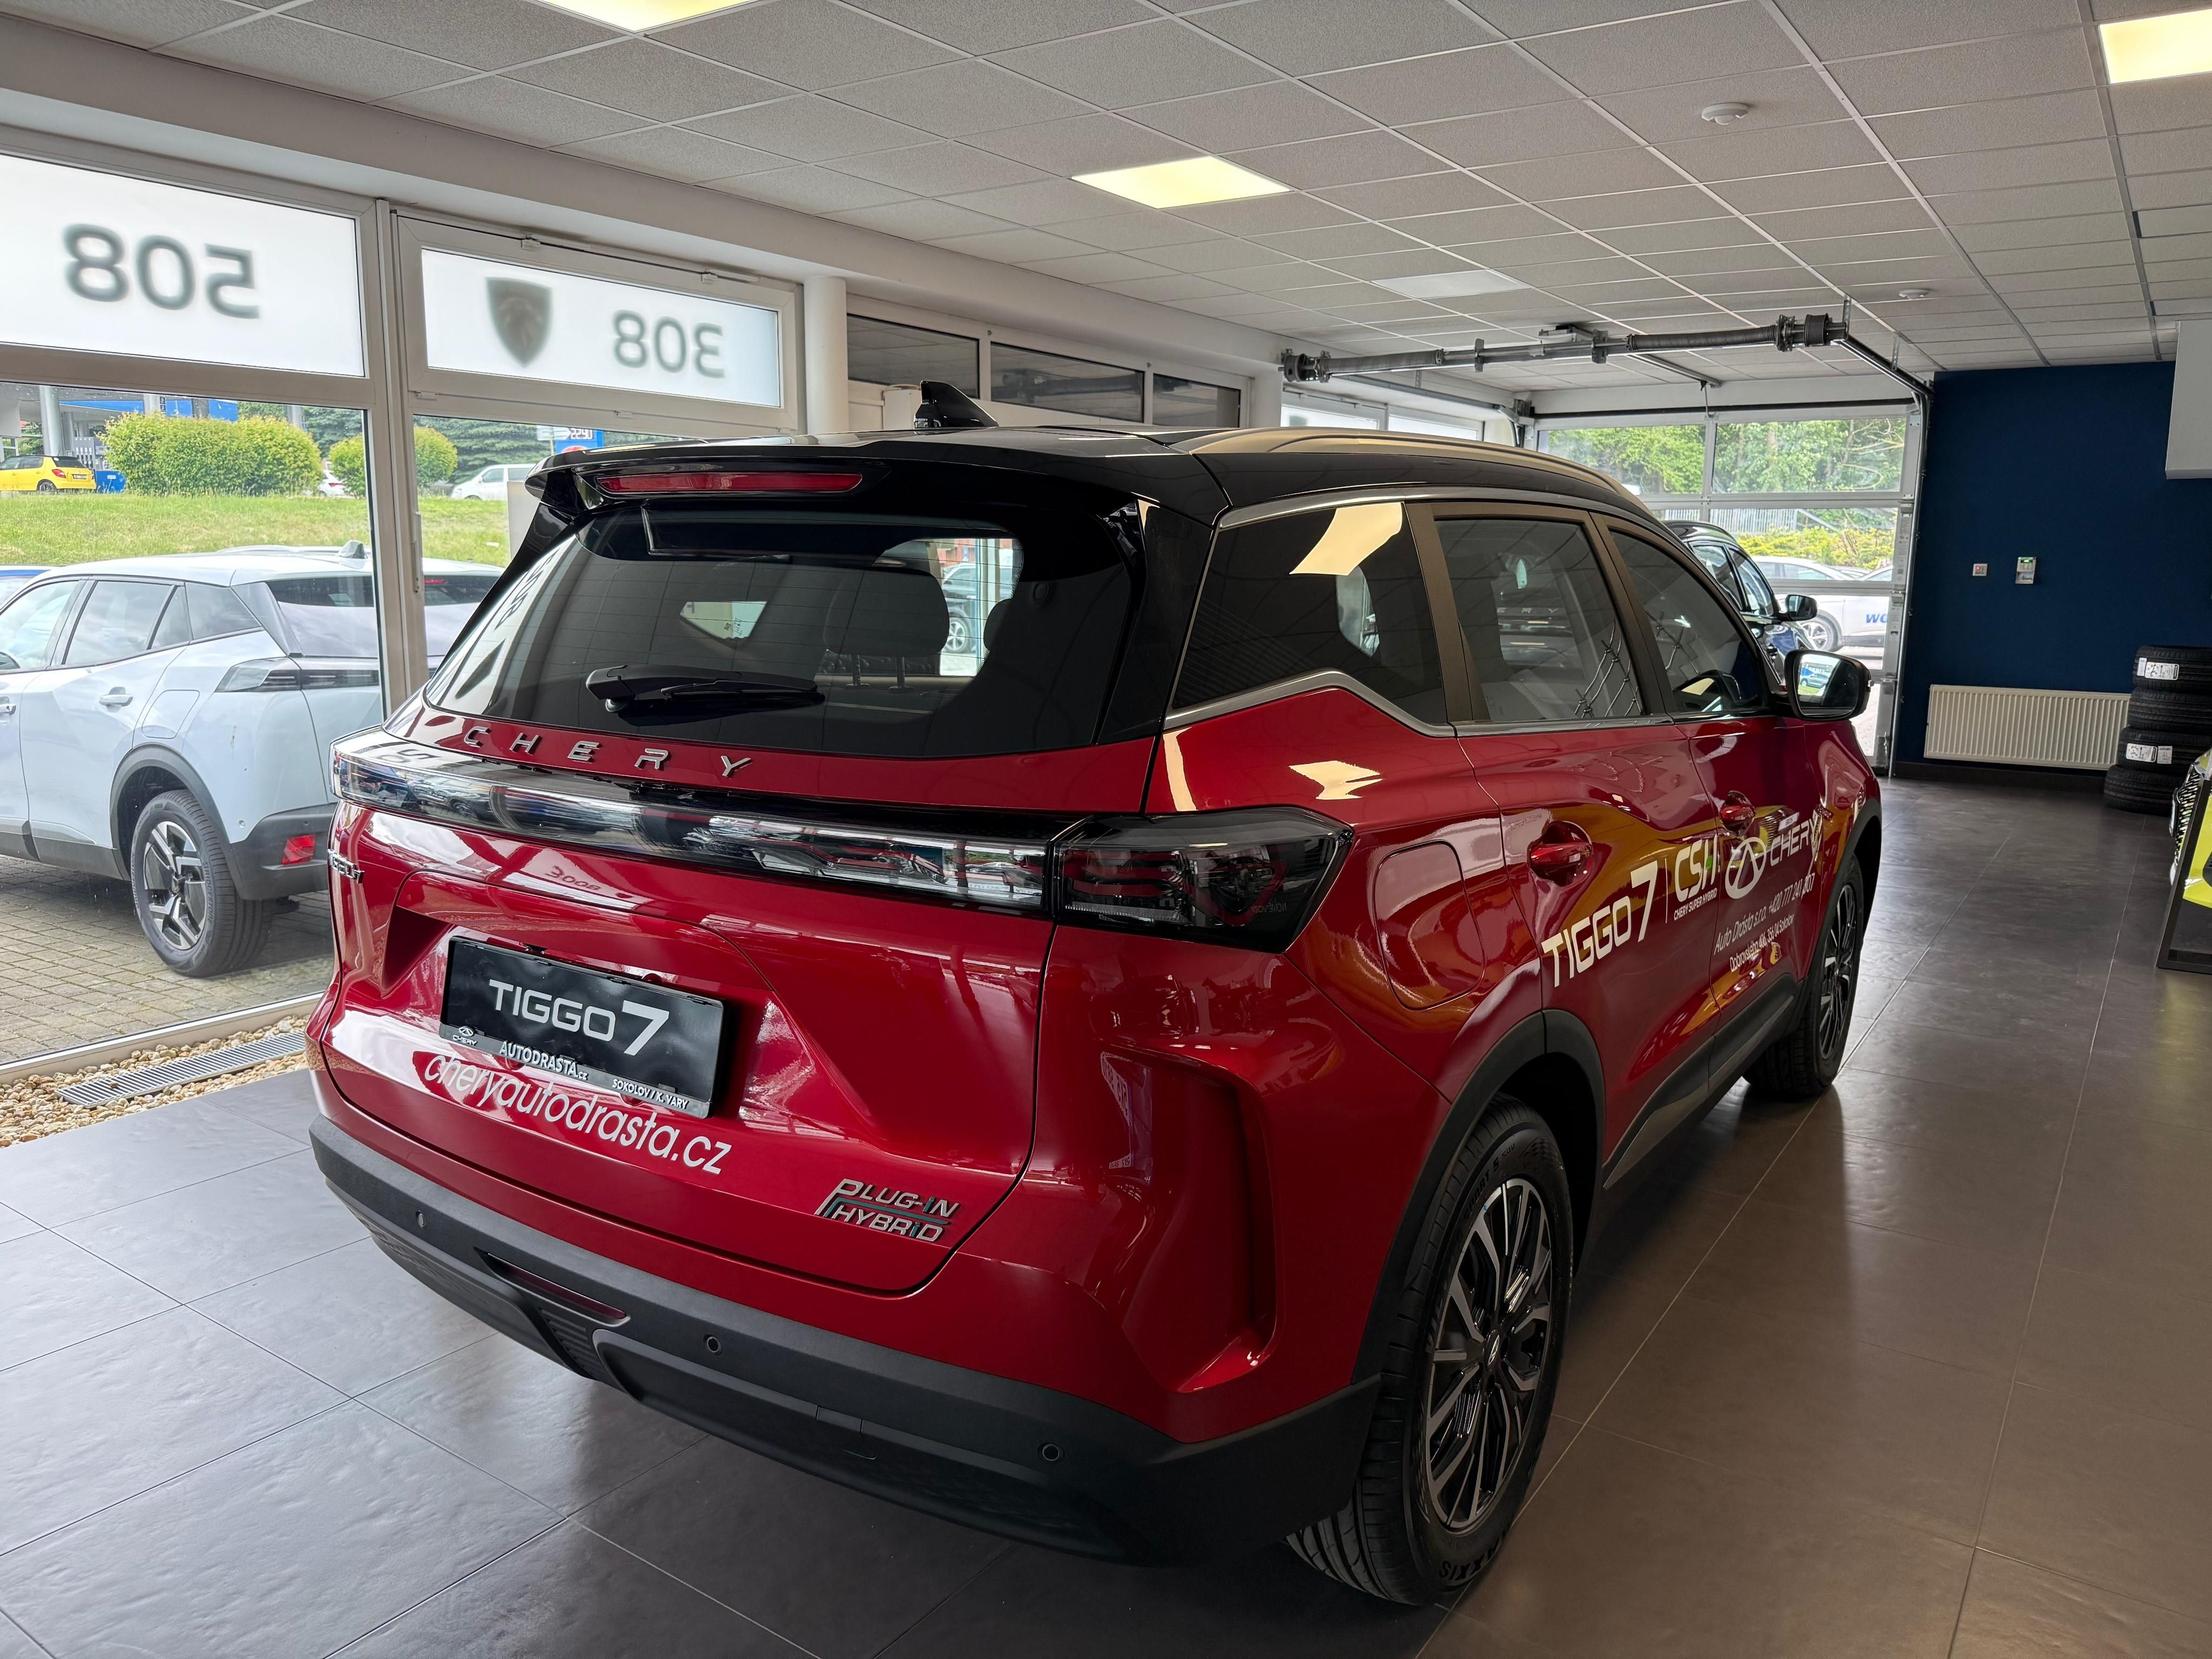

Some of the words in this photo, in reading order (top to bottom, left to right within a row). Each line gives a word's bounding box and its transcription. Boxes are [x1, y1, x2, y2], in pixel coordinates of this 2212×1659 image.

[463, 726, 752, 777] CHERY
[1675, 833, 1718, 902] CSH
[1674, 903, 1689, 921] CHERY
[1688, 895, 1702, 913] SUPER
[1541, 895, 1632, 988] TIGGO
[1714, 927, 1732, 955] Auto
[452, 1034, 478, 1046] CHERY
[489, 979, 616, 1042] TIGGO
[622, 1000, 670, 1056] 7
[424, 1054, 732, 1175] cheryautodrasta.cz
[611, 1078, 650, 1098] SOKOLOV
[656, 1091, 665, 1103] K.
[666, 1094, 690, 1109] VARY
